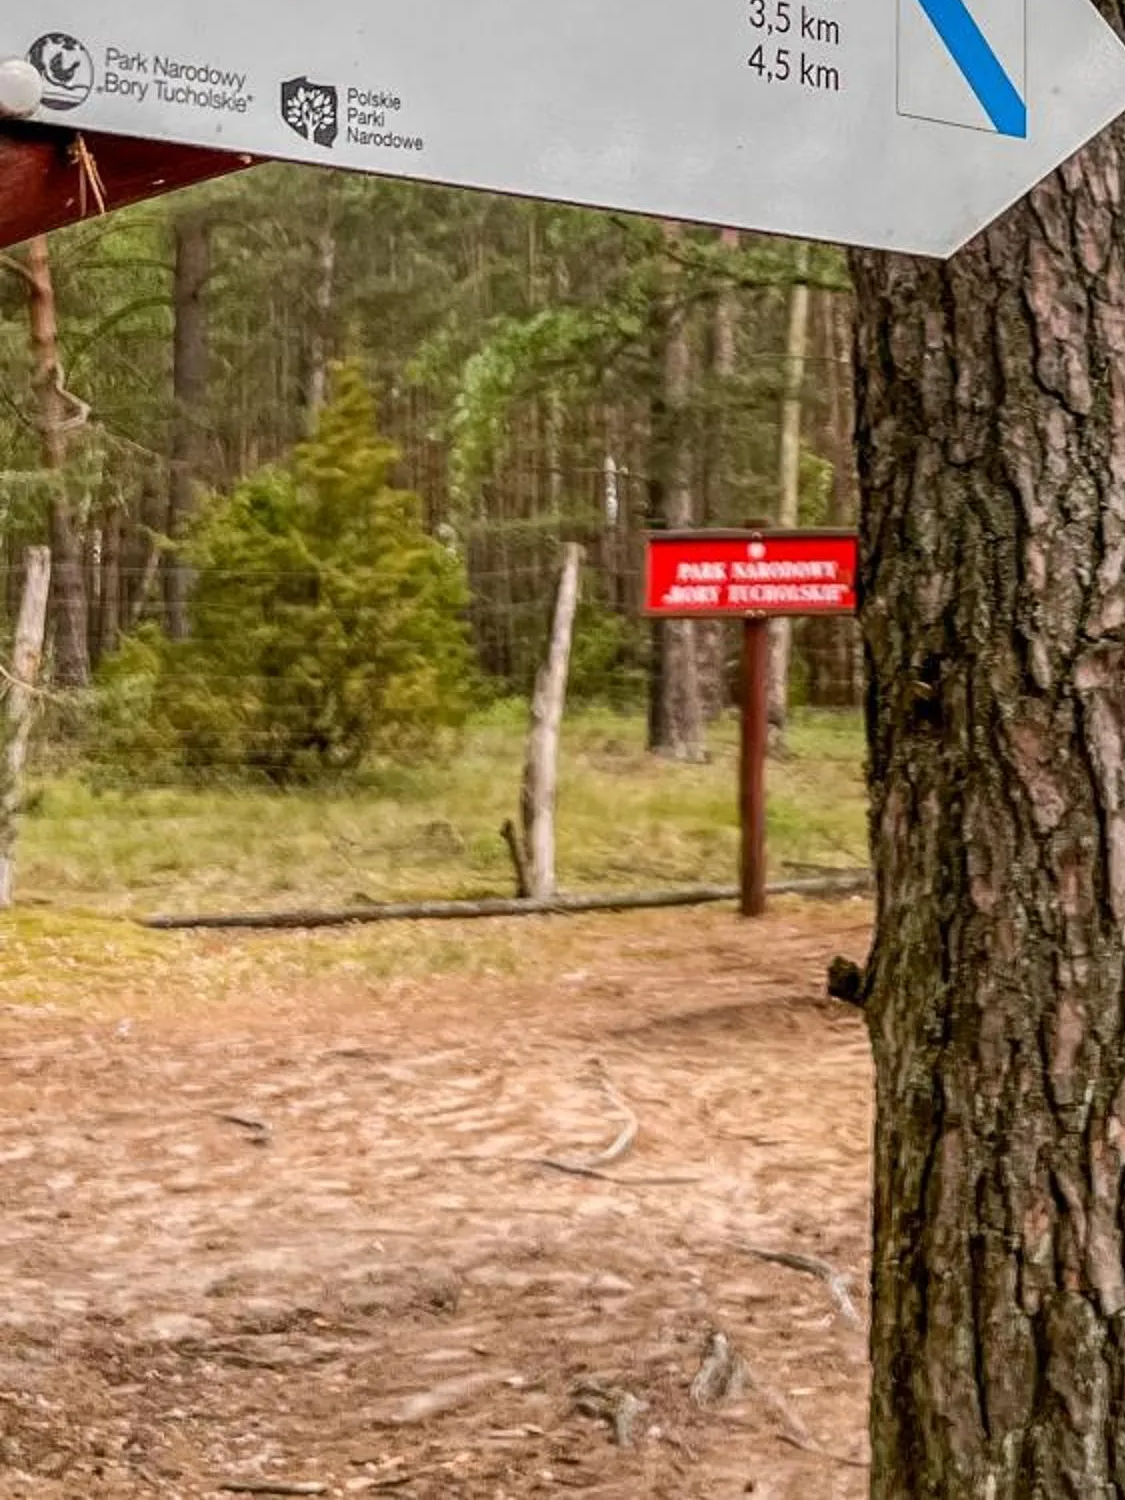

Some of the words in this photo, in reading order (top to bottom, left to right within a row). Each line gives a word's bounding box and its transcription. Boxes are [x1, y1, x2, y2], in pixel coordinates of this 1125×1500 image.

[801, 5, 839, 44] km
[105, 47, 148, 74] Park
[153, 55, 246, 93] Narodowy
[748, 44, 790, 83] 4,5
[800, 52, 839, 91] km
[347, 87, 401, 110] Polskie
[347, 108, 385, 127] Parki
[346, 127, 424, 151] Narodowe
